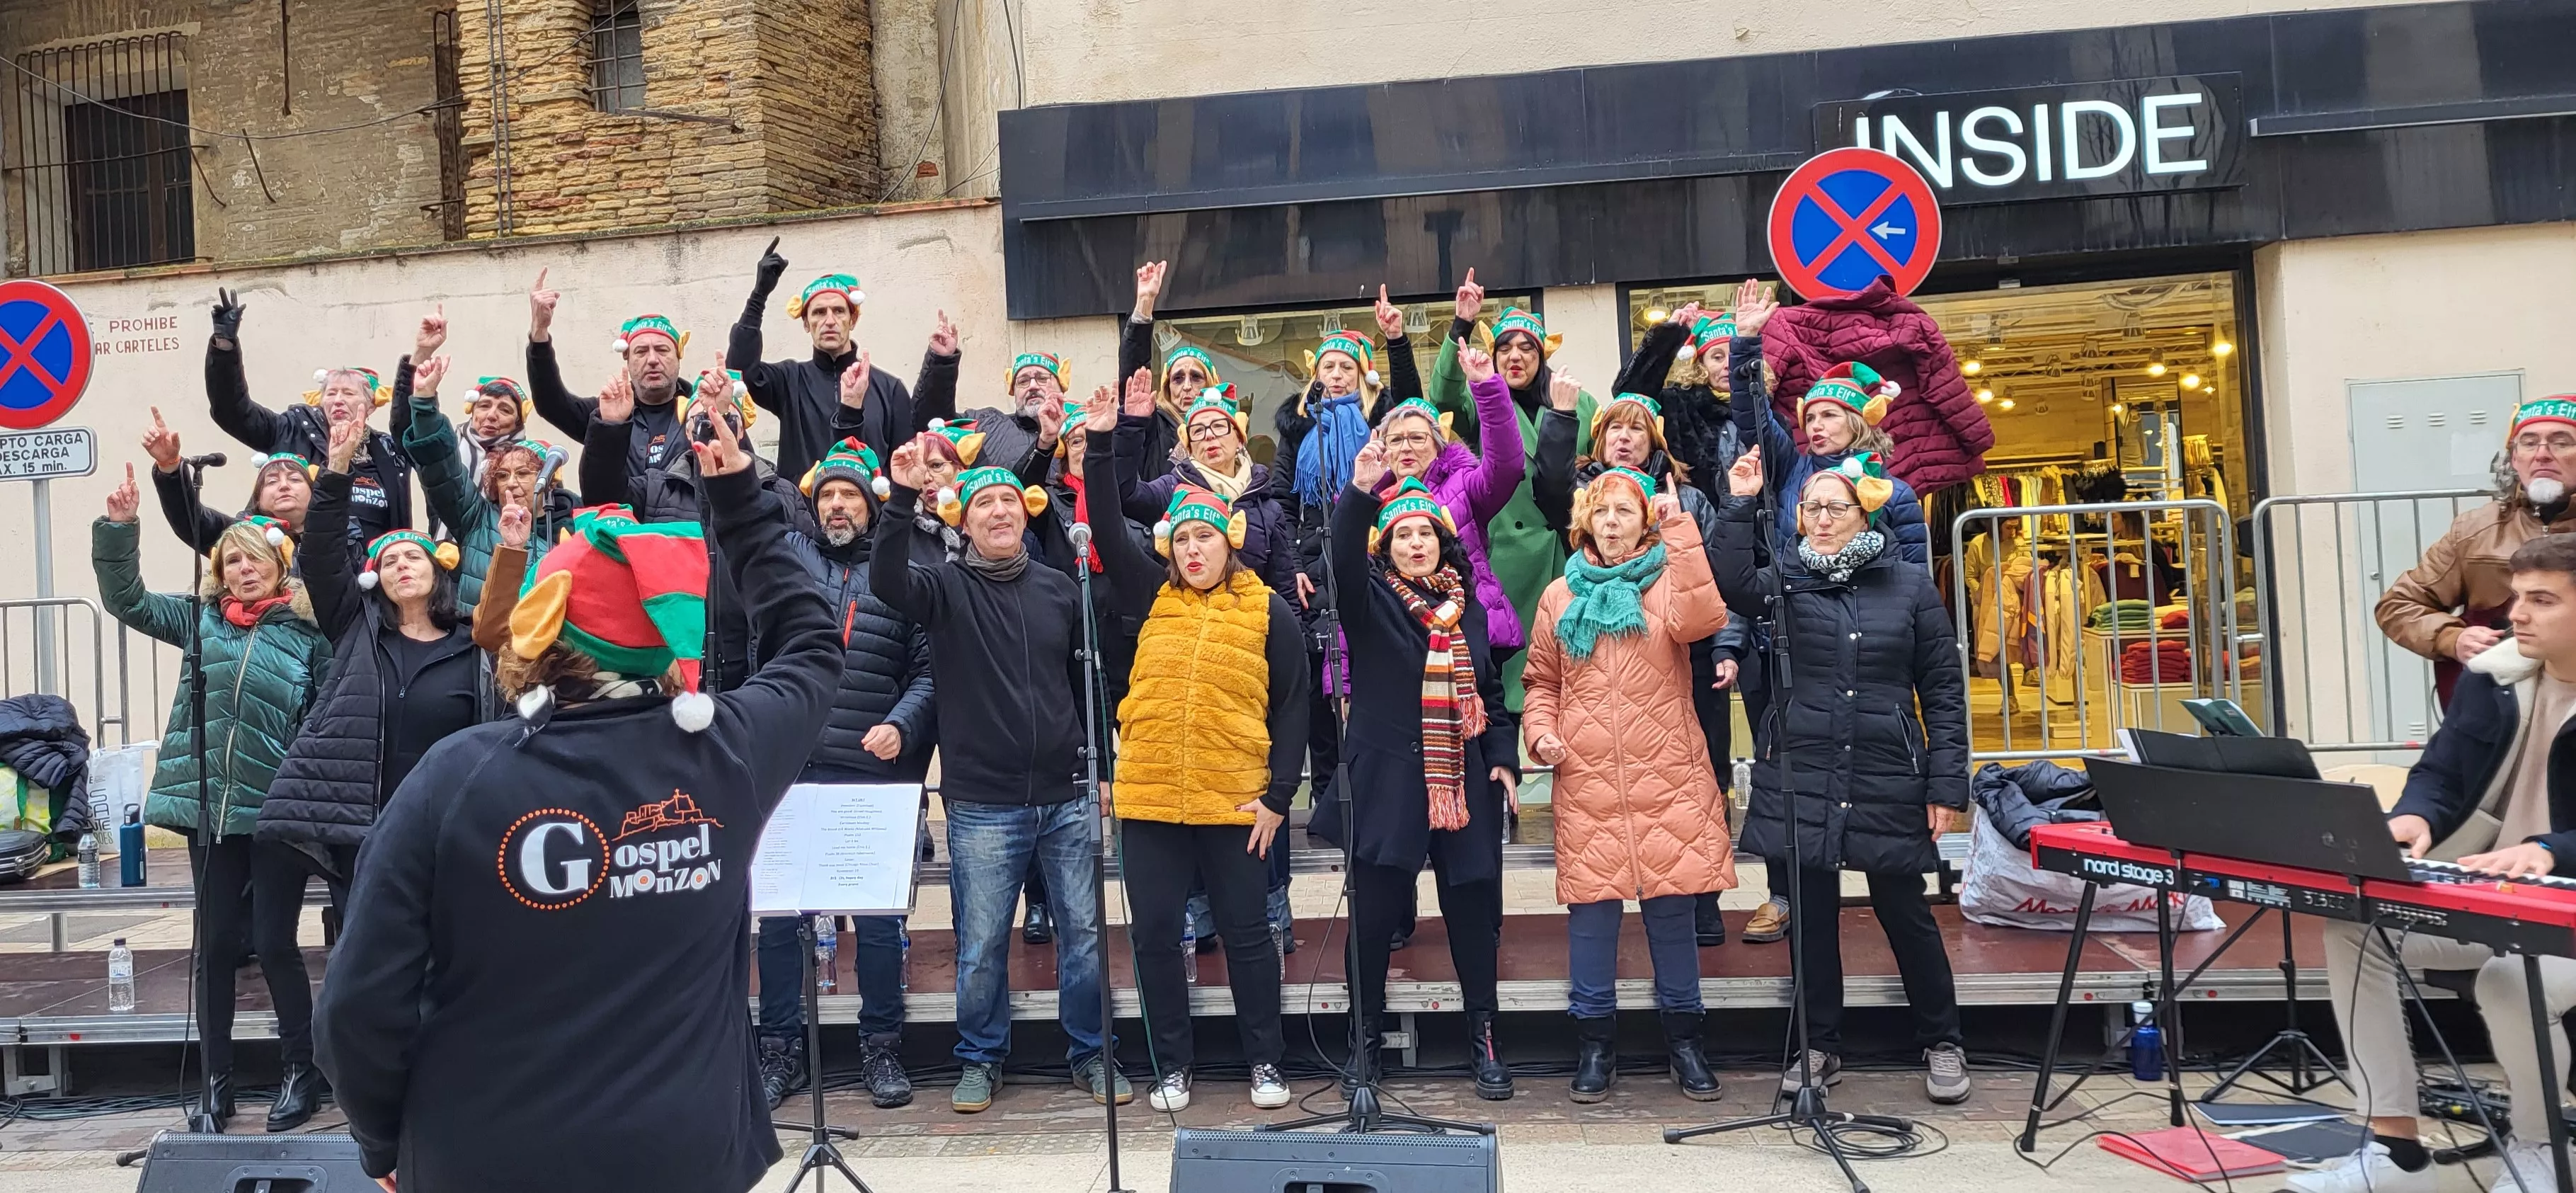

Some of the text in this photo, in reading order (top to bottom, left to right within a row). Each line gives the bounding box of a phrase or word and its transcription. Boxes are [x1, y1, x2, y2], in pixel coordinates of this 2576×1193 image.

[109, 316, 178, 333] PROHIBE
[1500, 318, 1531, 329] "Santa's
[1700, 324, 1734, 341] "Santa's
[95, 337, 180, 355] AR CARTELES
[0, 433, 84, 450] PTO CARGA
[0, 447, 70, 462] ESCARGA
[23, 462, 35, 474] 15
[42, 460, 67, 473] min.
[967, 470, 1002, 493] "Santa's
[1203, 508, 1220, 523] Elf"
[1382, 499, 1436, 523] "Santa's Elf"
[2083, 857, 2175, 885] nord stage 3
